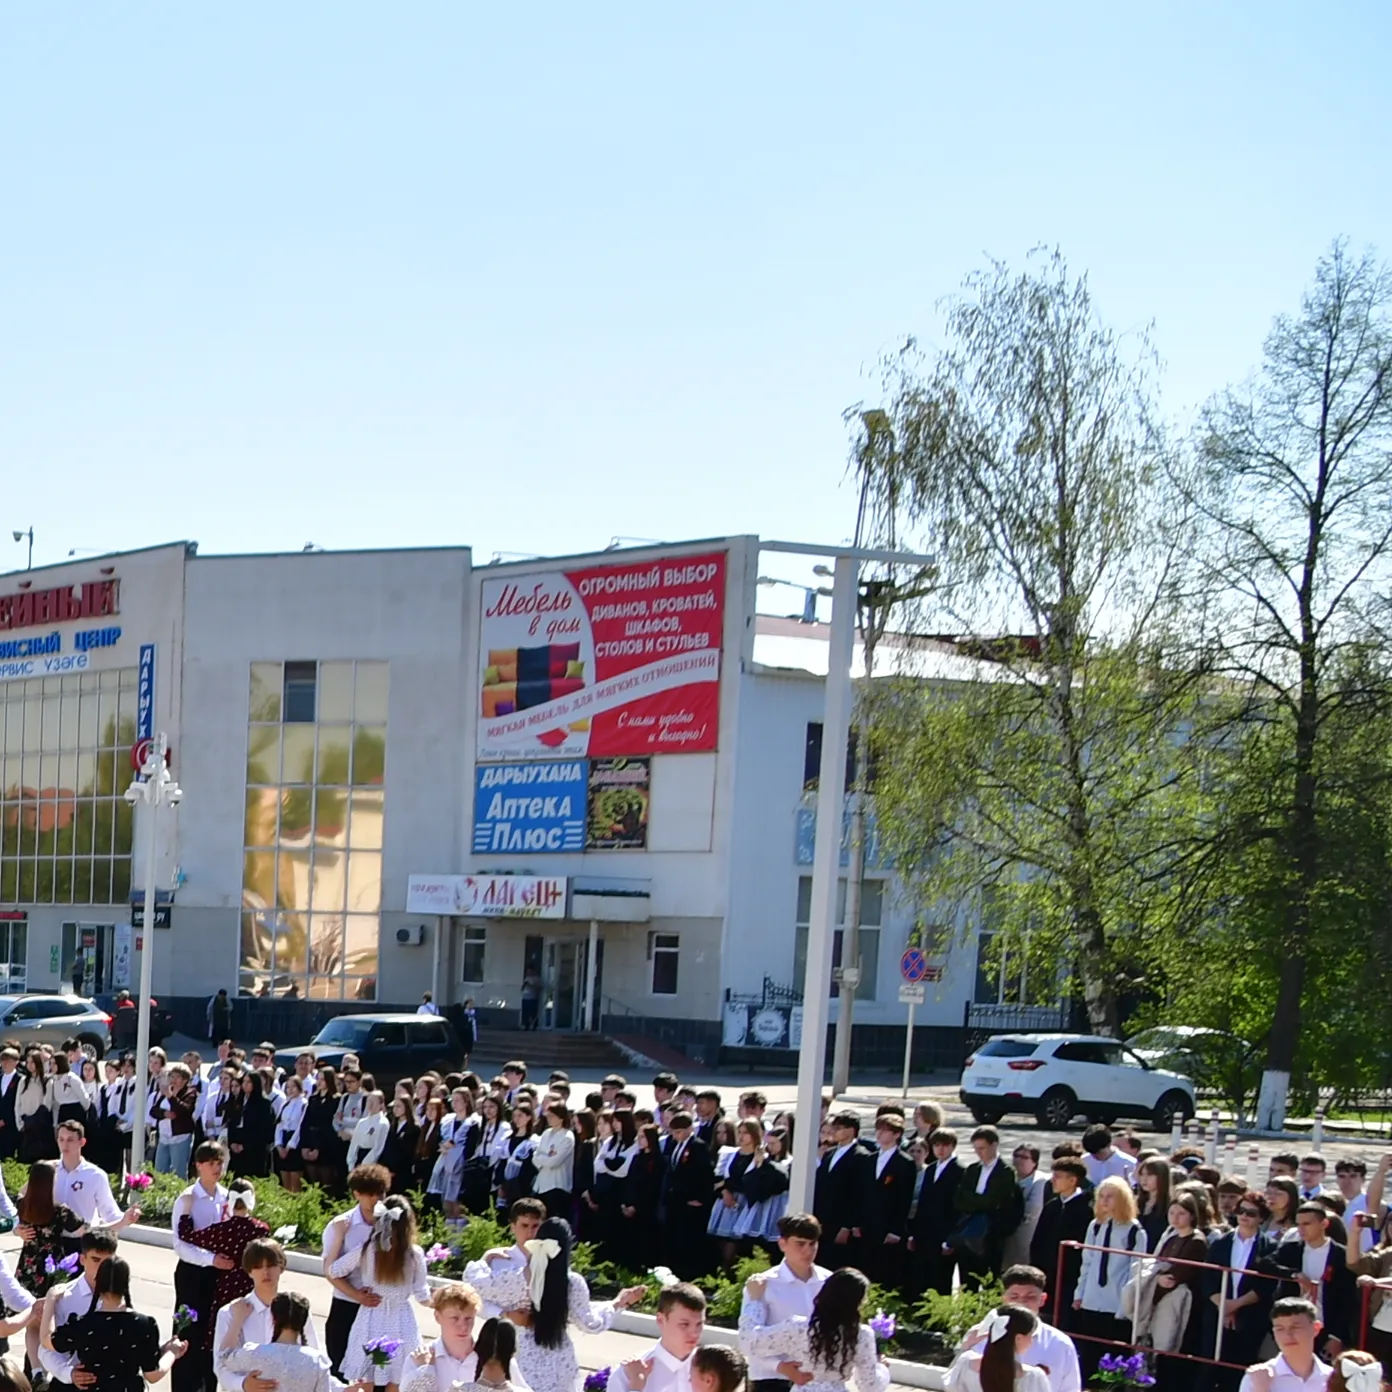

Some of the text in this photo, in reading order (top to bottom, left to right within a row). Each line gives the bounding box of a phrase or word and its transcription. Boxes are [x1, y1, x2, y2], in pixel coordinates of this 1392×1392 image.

[579, 563, 717, 597] ОГРОМНЫЙ ВЫБОР
[486, 583, 572, 618] Мебель
[591, 589, 717, 622] ДИВАНОВ, КРОВАТЕЙ,
[75, 626, 121, 650] ЦЕНТР
[528, 616, 581, 643] в дом
[625, 617, 682, 636] ШКАФОВ,
[595, 632, 709, 658] СТОЛОВ И СТУЛЬЕВ
[487, 654, 716, 738] МЯГКАЯ МЕБЕЛЬ ДЛЯ МЯГКИХ ОТНОШЕНИЙ
[659, 708, 694, 729] удобно
[480, 763, 582, 789] ДАРЫУХАНА
[486, 792, 571, 820] Аптека
